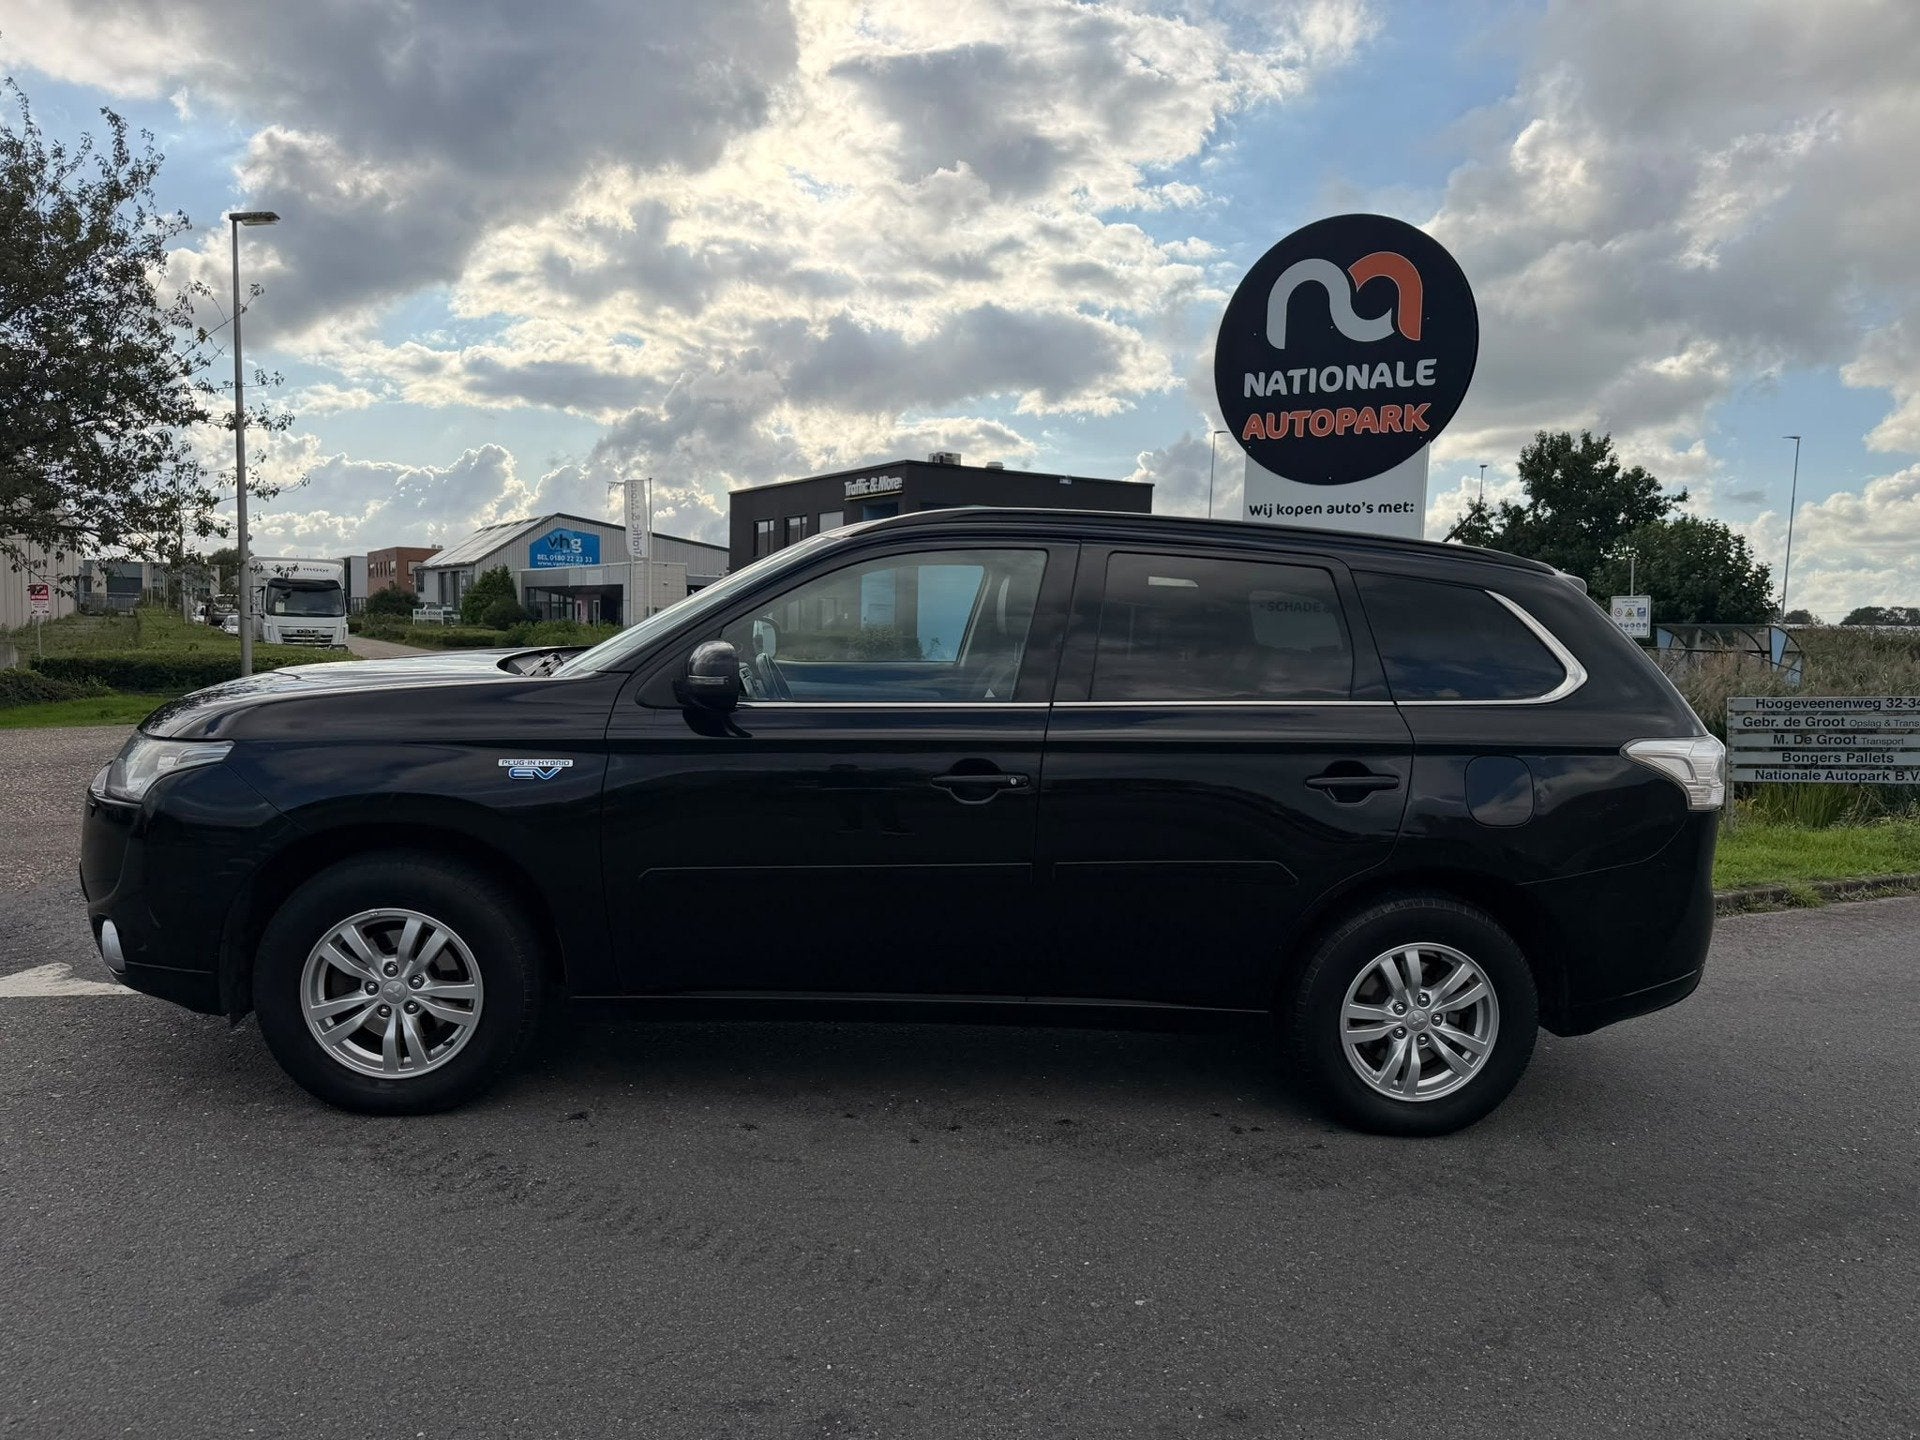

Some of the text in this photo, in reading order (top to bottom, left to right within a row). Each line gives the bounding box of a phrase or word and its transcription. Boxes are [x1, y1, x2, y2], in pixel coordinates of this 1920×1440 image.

[1243, 359, 1437, 398] NATIONALE
[1242, 402, 1432, 441] AUTOPARK
[1276, 503, 1323, 517] kopen
[1377, 501, 1414, 514] met:
[547, 534, 582, 554] vhg
[1267, 601, 1321, 612] SCHADE
[1756, 699, 1880, 711] Hoogeveenenweg
[1743, 717, 1779, 727] Gebr.
[1784, 717, 1800, 727] de
[1805, 717, 1845, 727] Groot
[1849, 720, 1881, 729] Opslag
[1773, 735, 1904, 747] M. De Groot Transport
[1782, 752, 1895, 766] Bongers Pallets
[509, 766, 563, 780] EV
[1755, 770, 1821, 781] Nationale
[1825, 770, 1890, 783] Autopark
